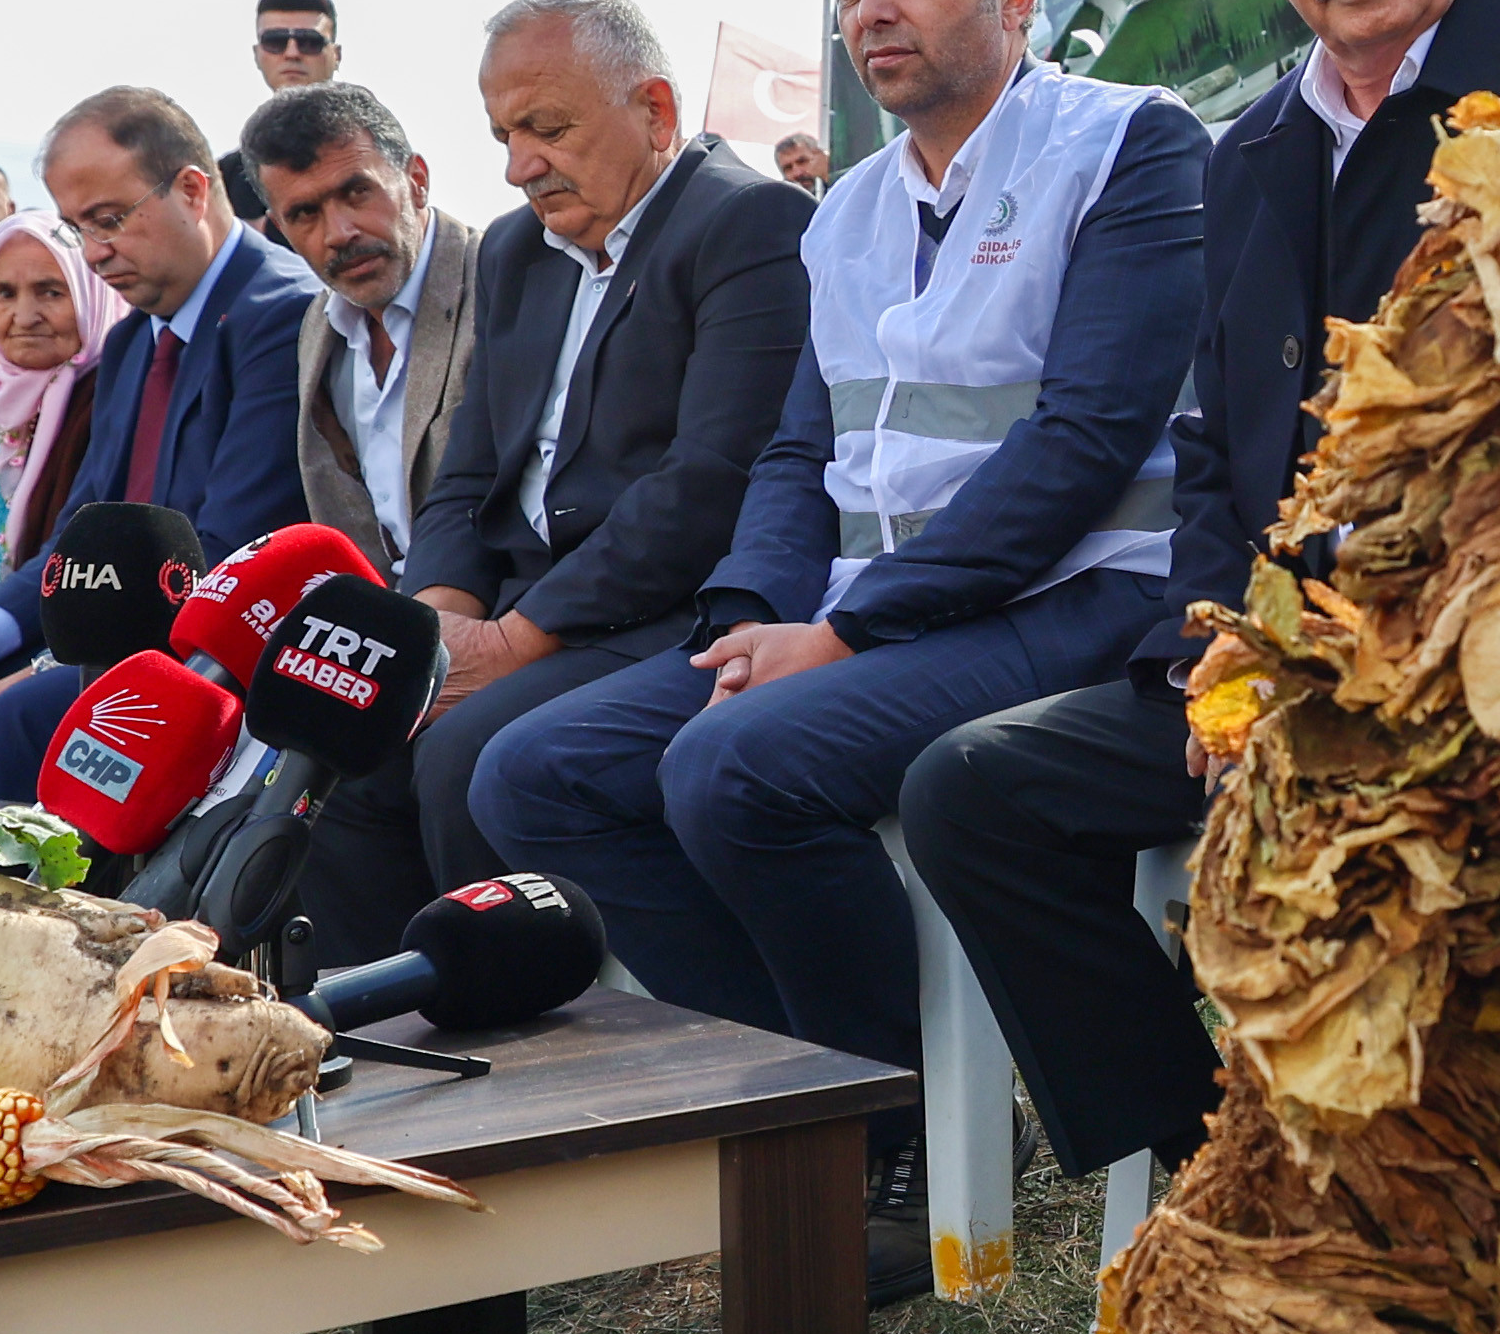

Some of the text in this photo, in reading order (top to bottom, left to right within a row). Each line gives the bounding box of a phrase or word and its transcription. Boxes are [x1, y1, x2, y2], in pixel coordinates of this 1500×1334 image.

[61, 557, 123, 591] İHA
[240, 610, 272, 642] HABE
[298, 615, 397, 677] TRT
[277, 649, 374, 706] HABER
[63, 739, 133, 788] CHP
